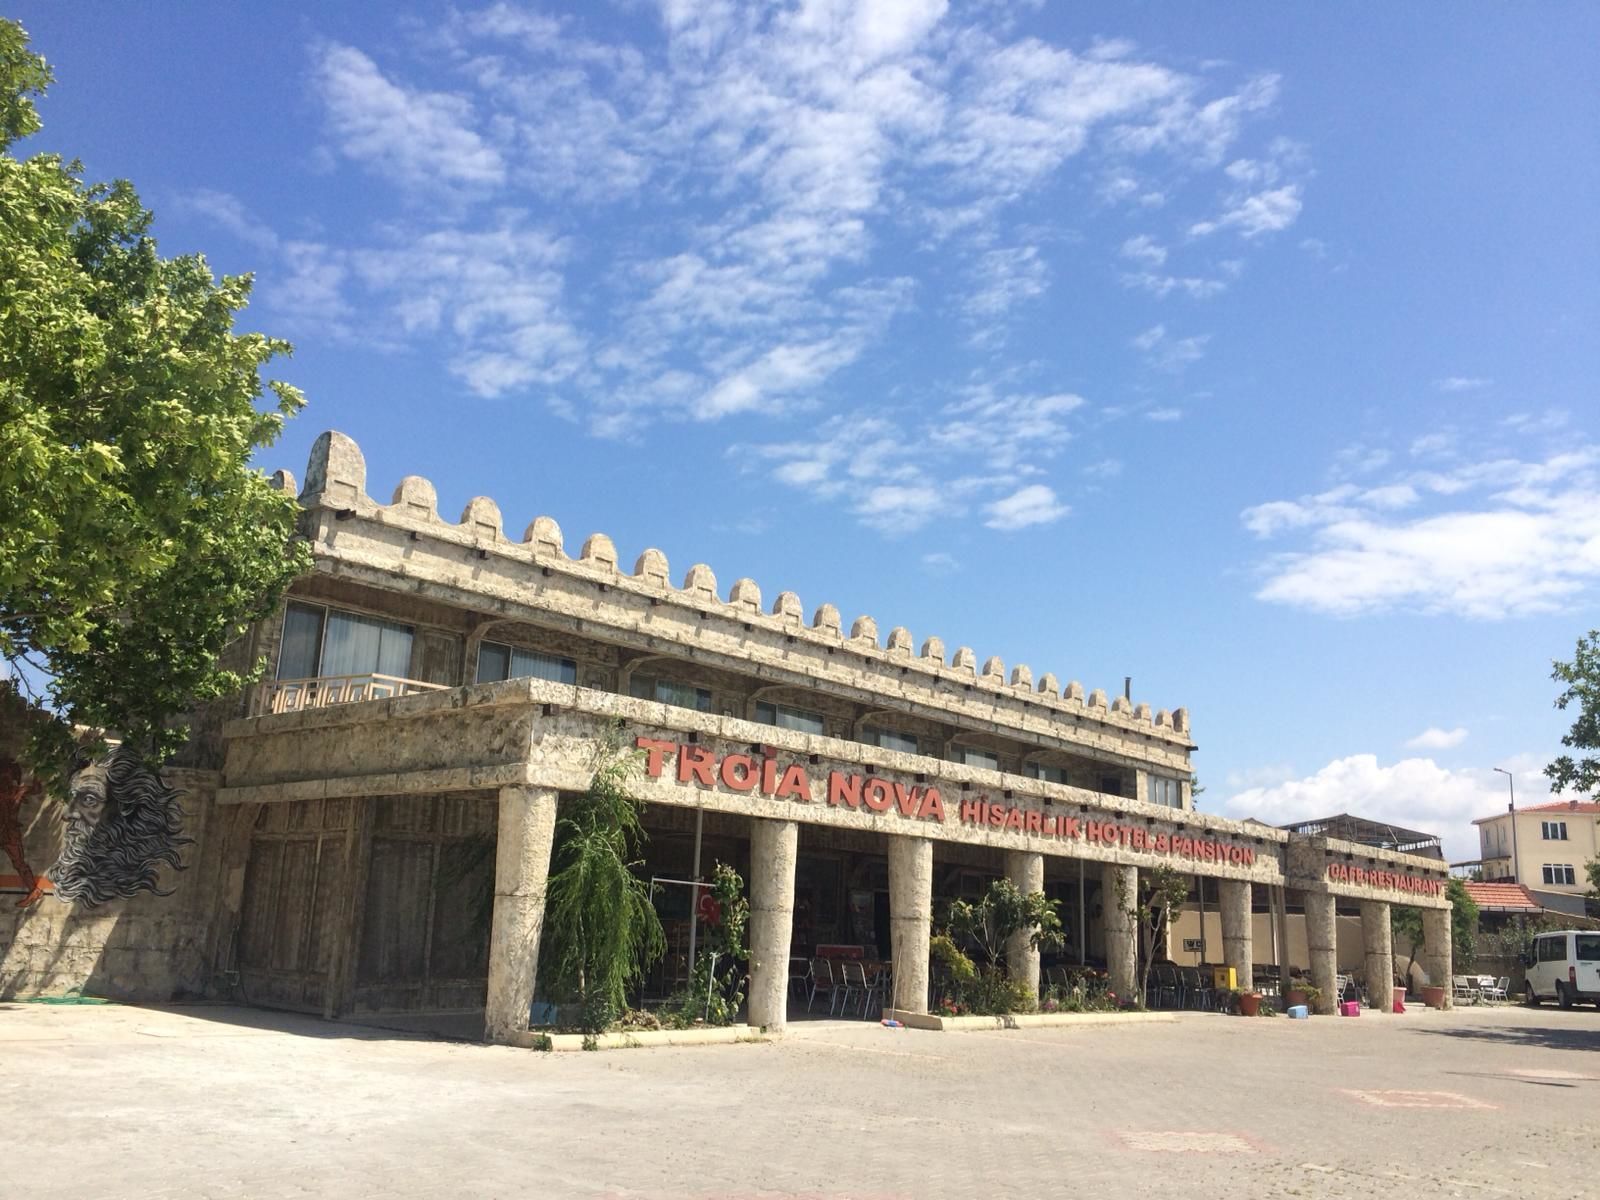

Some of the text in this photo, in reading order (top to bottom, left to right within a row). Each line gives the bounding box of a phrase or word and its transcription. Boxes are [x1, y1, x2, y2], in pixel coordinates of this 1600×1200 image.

[826, 771, 946, 823] NOVA
[1086, 821, 1155, 850] HOTEL
[1155, 832, 1170, 851] &
